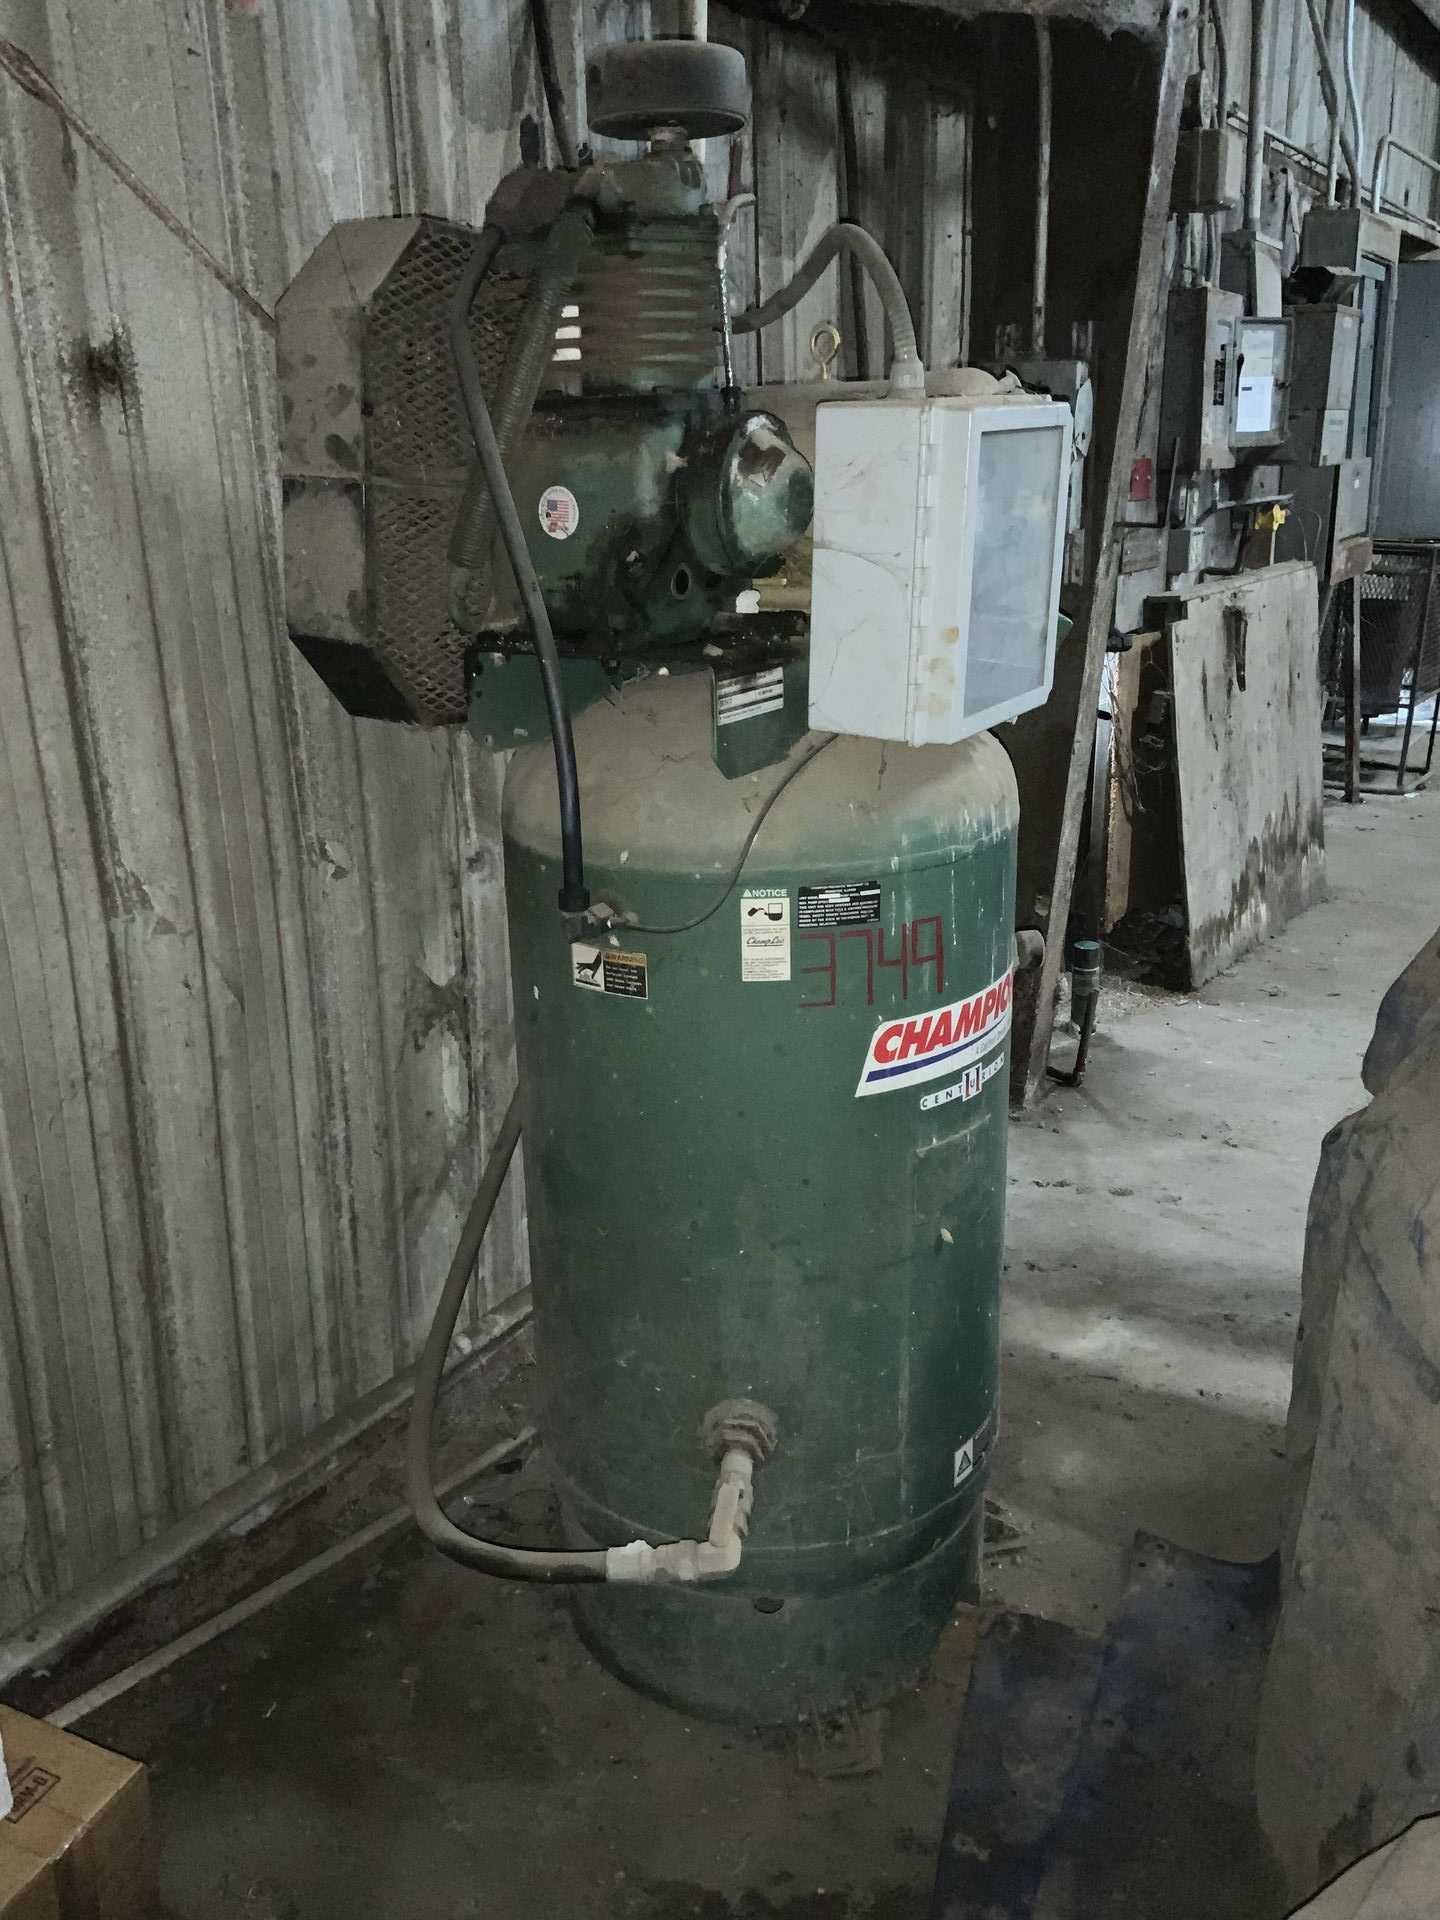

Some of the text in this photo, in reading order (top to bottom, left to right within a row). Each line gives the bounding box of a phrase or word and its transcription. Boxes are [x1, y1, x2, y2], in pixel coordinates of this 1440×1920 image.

[752, 888, 788, 897] NOTICE
[799, 915, 944, 1007] 3749
[873, 973, 1011, 1064] CHAMPIO
